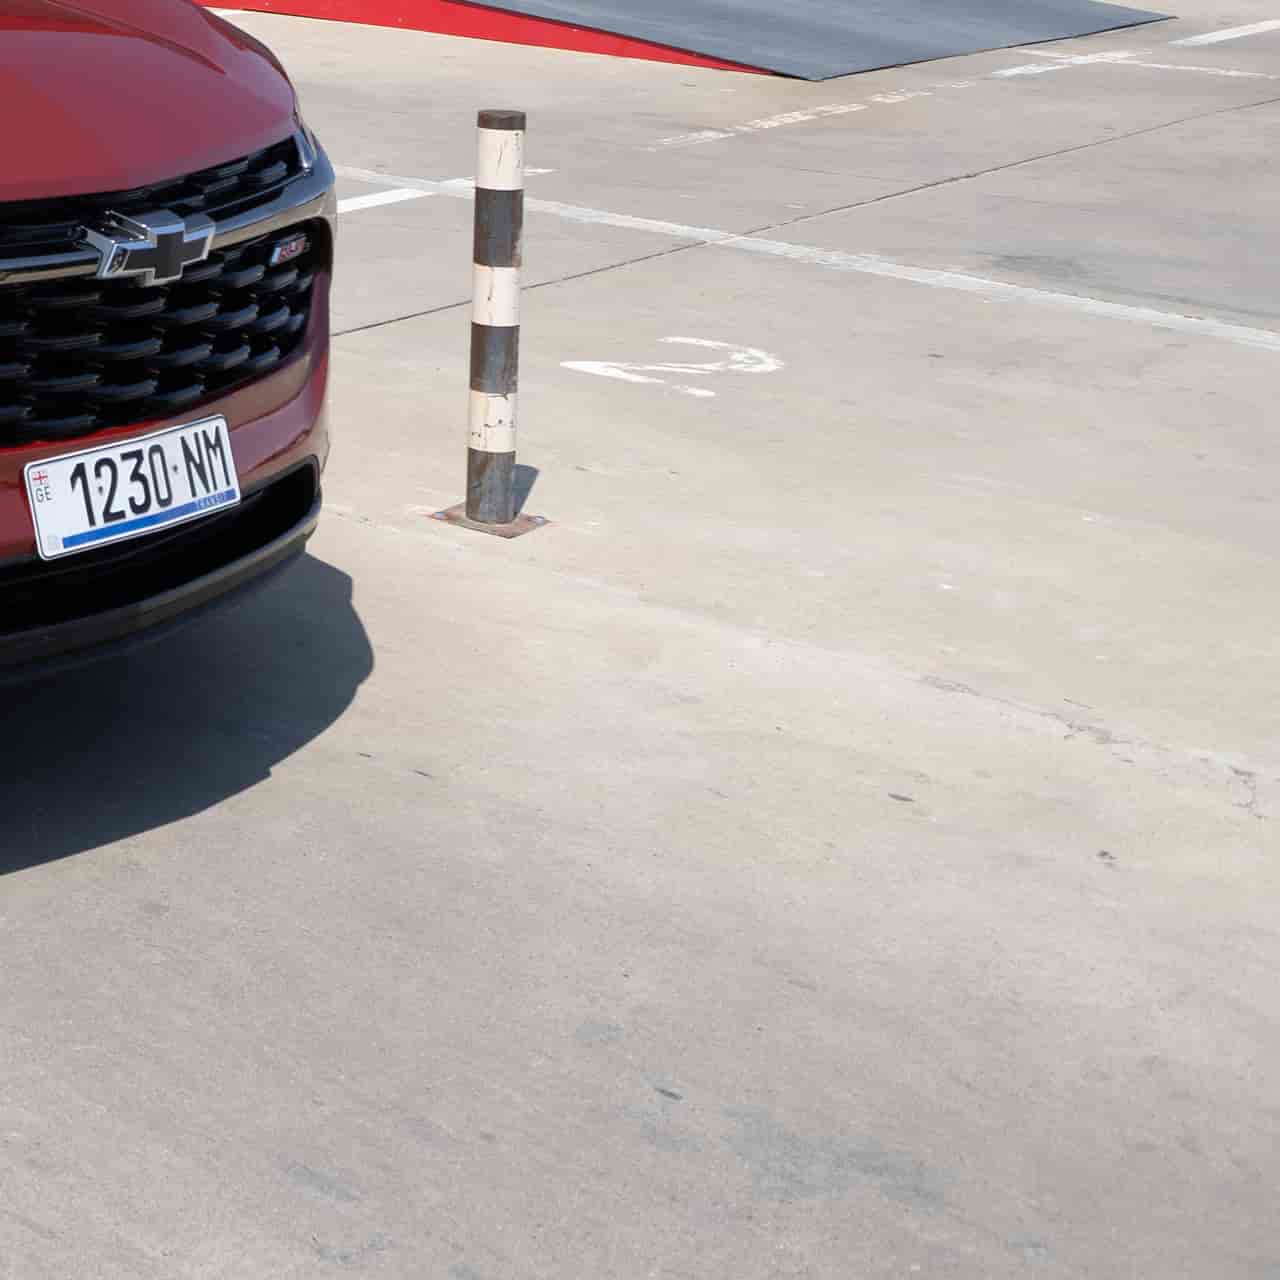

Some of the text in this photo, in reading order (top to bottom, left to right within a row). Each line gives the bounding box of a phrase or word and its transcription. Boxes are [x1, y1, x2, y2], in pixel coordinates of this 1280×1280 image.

[34, 486, 53, 503] GE
[70, 425, 231, 527] 1230 NM
